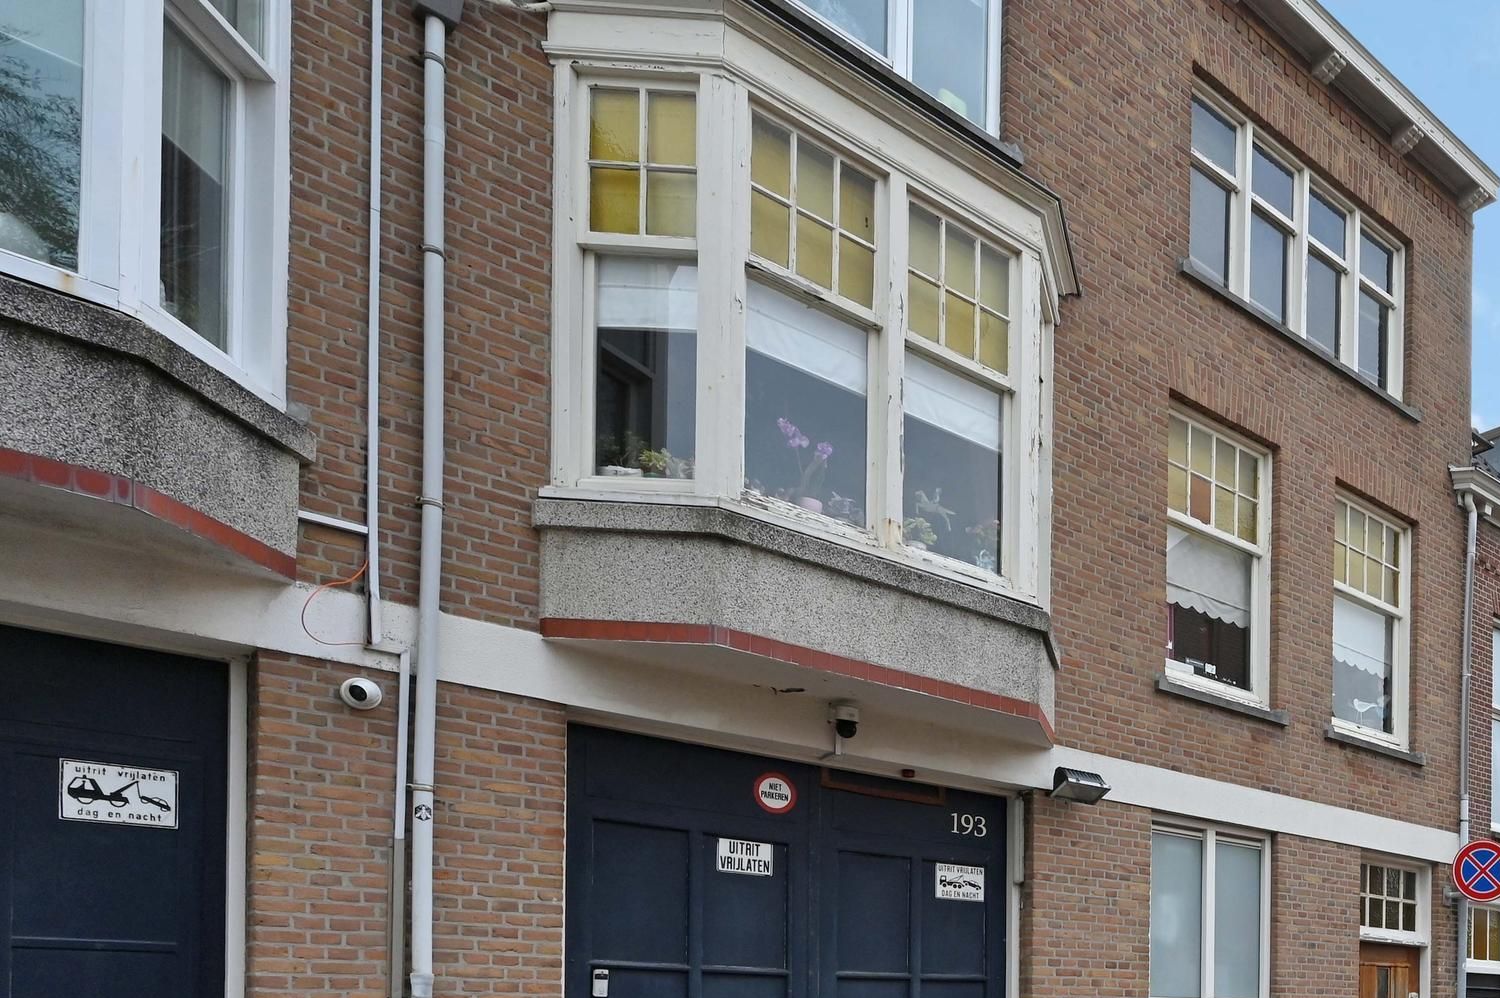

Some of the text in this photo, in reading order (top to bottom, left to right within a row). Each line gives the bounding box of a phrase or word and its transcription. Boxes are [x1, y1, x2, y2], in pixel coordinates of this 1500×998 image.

[75, 766, 166, 782] uitrit vrijlaten
[768, 782, 782, 791] NIET
[760, 790, 789, 802] PARKEREN
[77, 808, 99, 818] dag
[128, 812, 161, 822] nacht
[951, 812, 987, 838] 193
[729, 841, 760, 857] UITRIT
[720, 855, 770, 874] VRIJLATEN
[938, 864, 983, 876] UITRIT VRIJLATEN
[941, 889, 979, 899] DAG EN NACHT
